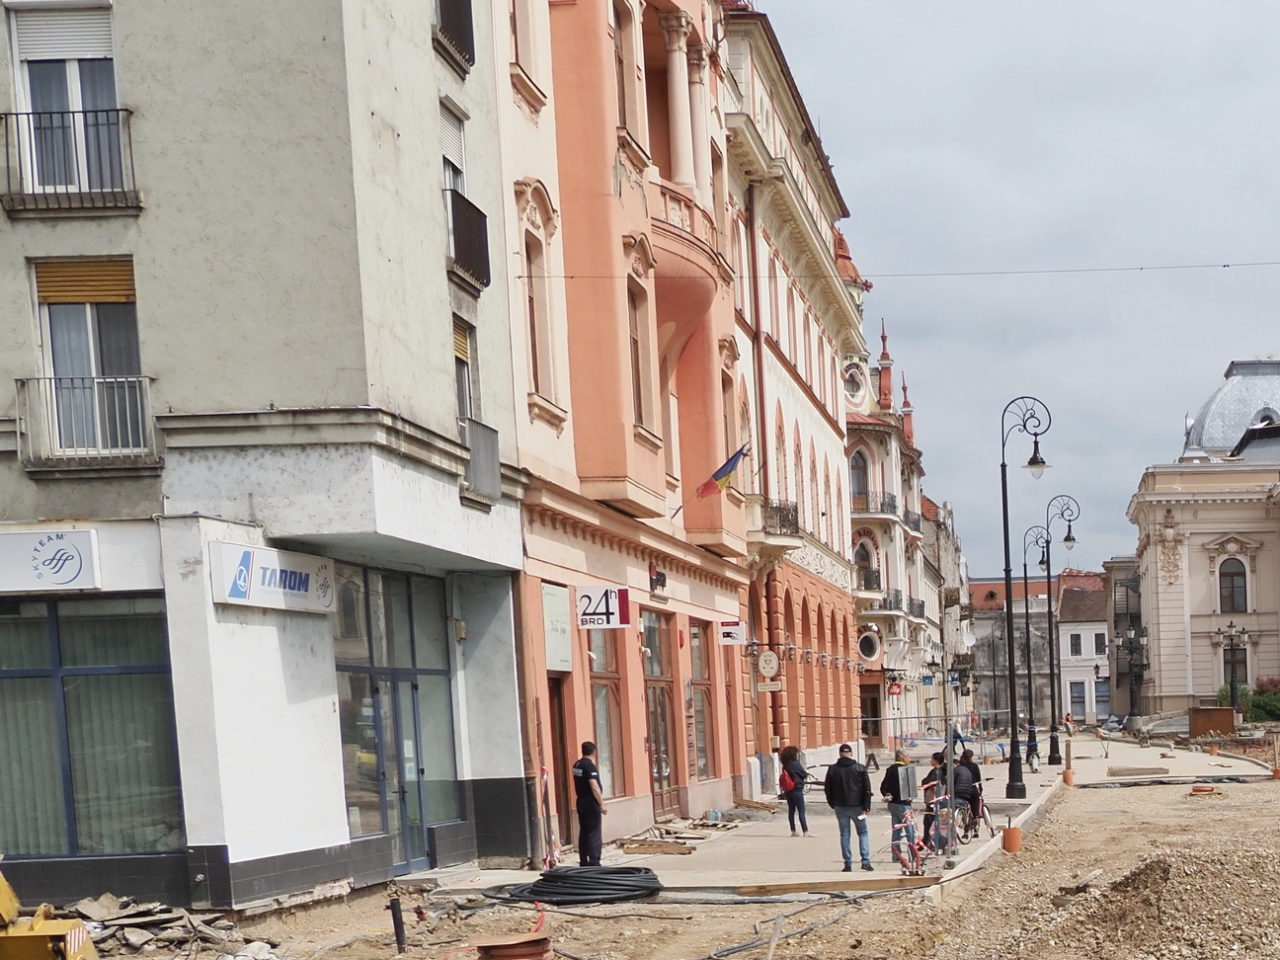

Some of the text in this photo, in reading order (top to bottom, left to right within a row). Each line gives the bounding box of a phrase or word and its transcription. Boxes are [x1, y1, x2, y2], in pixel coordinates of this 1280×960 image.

[32, 533, 65, 580] SKYTEAM
[260, 566, 310, 593] TAROM
[581, 617, 605, 626] BRD
